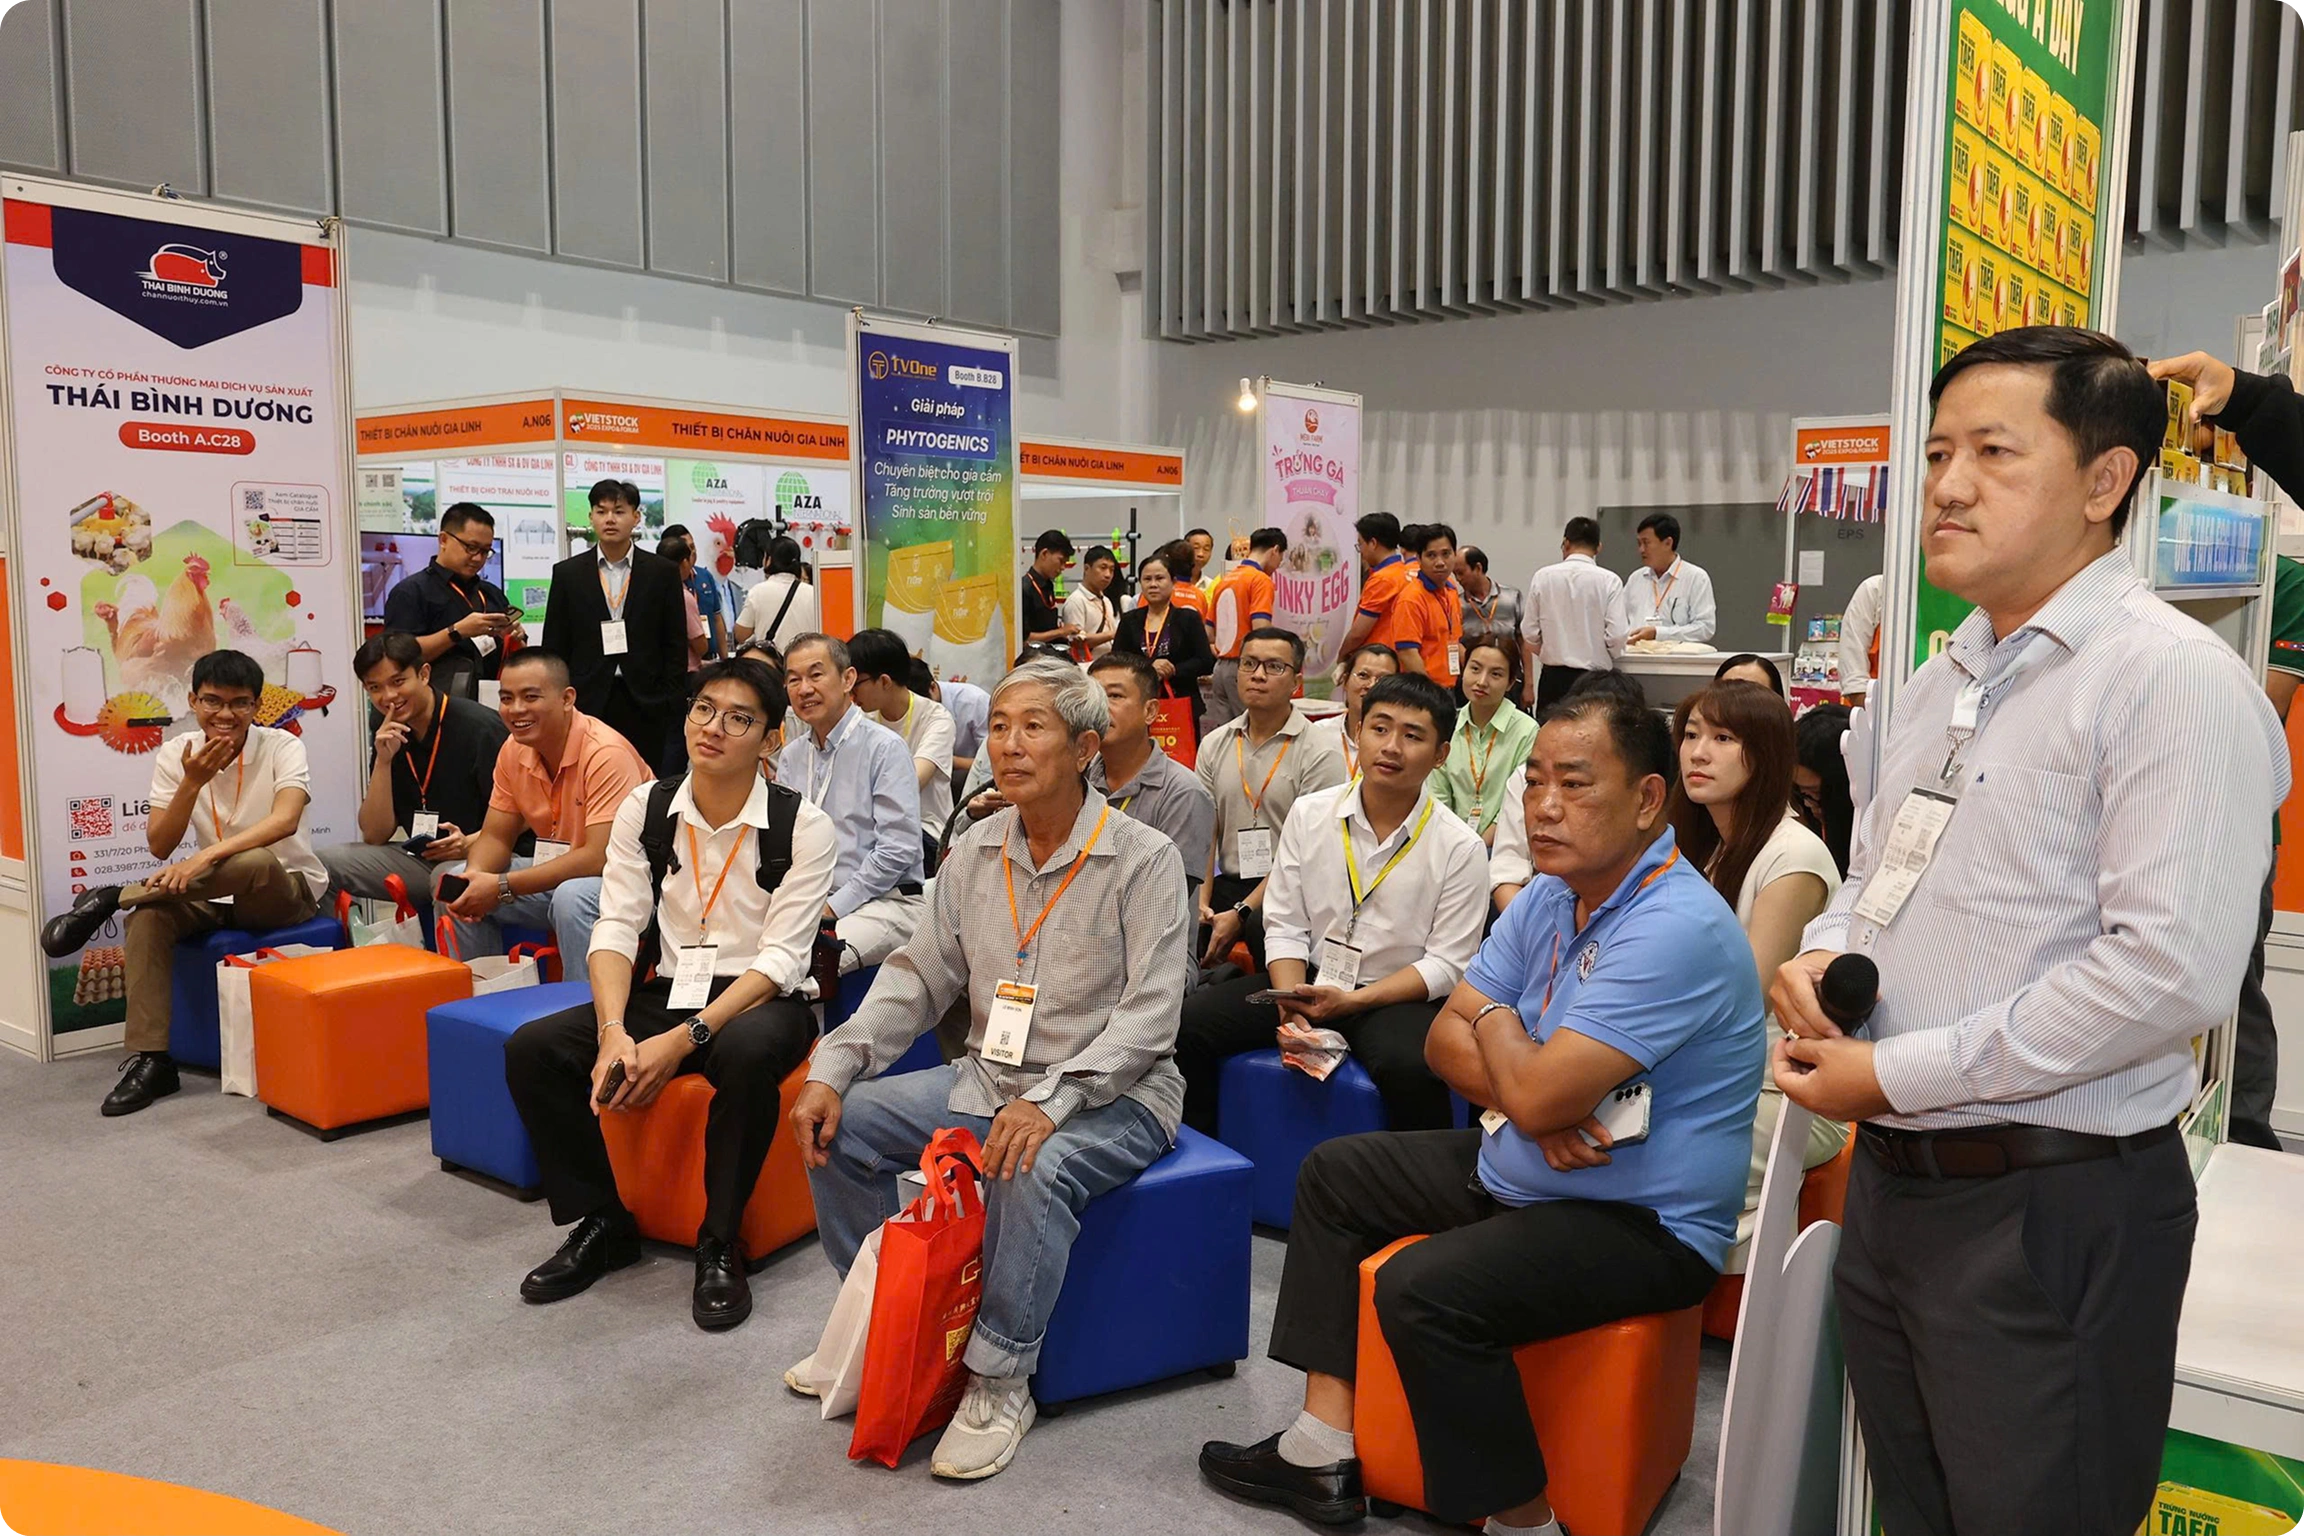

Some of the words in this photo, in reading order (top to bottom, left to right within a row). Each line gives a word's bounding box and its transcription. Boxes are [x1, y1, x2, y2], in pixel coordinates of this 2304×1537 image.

[141, 280, 165, 291] THAI
[166, 283, 191, 295] BINH
[192, 286, 228, 299] DUONG
[141, 290, 229, 307] channuoithuy.com.vn
[891, 356, 938, 377] TVOne
[45, 364, 79, 377] CÔNG
[81, 368, 96, 378] TY
[97, 368, 115, 380] CỔ
[117, 370, 149, 383] PHẦN
[151, 374, 197, 387] THƯƠNG
[199, 379, 219, 391] MẠI
[221, 381, 247, 393] DỊCH
[248, 384, 263, 394] VỤ
[265, 383, 285, 395] SẢN
[287, 385, 314, 397] XUẤT
[954, 370, 975, 382] Booth
[976, 372, 997, 385] B.B28
[46, 383, 120, 410] THÁI
[131, 387, 203, 416] BÌNH
[213, 397, 313, 425] DƯƠNG
[911, 398, 934, 414] Giải
[935, 402, 965, 419] pháp
[443, 423, 459, 434] GIA
[461, 421, 482, 433] LINH
[522, 413, 552, 428] A.N06
[583, 412, 639, 427] VIETSTOCK
[138, 428, 190, 445] Booth
[194, 433, 241, 448] A.C28
[672, 421, 708, 437] THIẾT
[711, 426, 723, 441] BỊ
[727, 425, 762, 441] CHĂN
[764, 428, 794, 444] NUÔI
[797, 433, 817, 446] GIA
[819, 435, 845, 448] LINH
[886, 428, 989, 453] PHYTOGENICS
[1820, 437, 1879, 449] VIETSTOCK
[1032, 455, 1041, 467] BỊ
[1068, 456, 1089, 468] NUÔI
[1090, 459, 1105, 469] GIA
[1106, 460, 1124, 471] LINH
[1157, 465, 1179, 476] A.N06
[874, 461, 916, 480] Chuyên
[918, 463, 939, 481] biệt
[940, 466, 960, 480] cho
[962, 468, 978, 484] gia
[980, 466, 1002, 483] cầm
[1326, 460, 1344, 486] GÀ
[480, 486, 497, 495] CHO
[534, 489, 550, 497] HEO
[706, 478, 728, 489] AZA
[794, 494, 822, 509] AZA
[884, 482, 911, 501] Tăng
[913, 484, 949, 503] trưởng
[951, 489, 975, 504] vượt
[977, 489, 995, 505] trội
[891, 504, 916, 519] Sinh
[917, 504, 937, 520] sản
[938, 503, 959, 520] bền
[961, 508, 988, 524] vững
[1837, 528, 1864, 539] EPS
[1321, 560, 1349, 614] EGG
[122, 799, 151, 817] Liê
[311, 827, 331, 835] Minh
[93, 847, 132, 859] 331/7/20
[94, 860, 163, 875] 028.3987.7349
[990, 1047, 1014, 1059] VISITOR
[2158, 1511, 2217, 1536] TAFA
